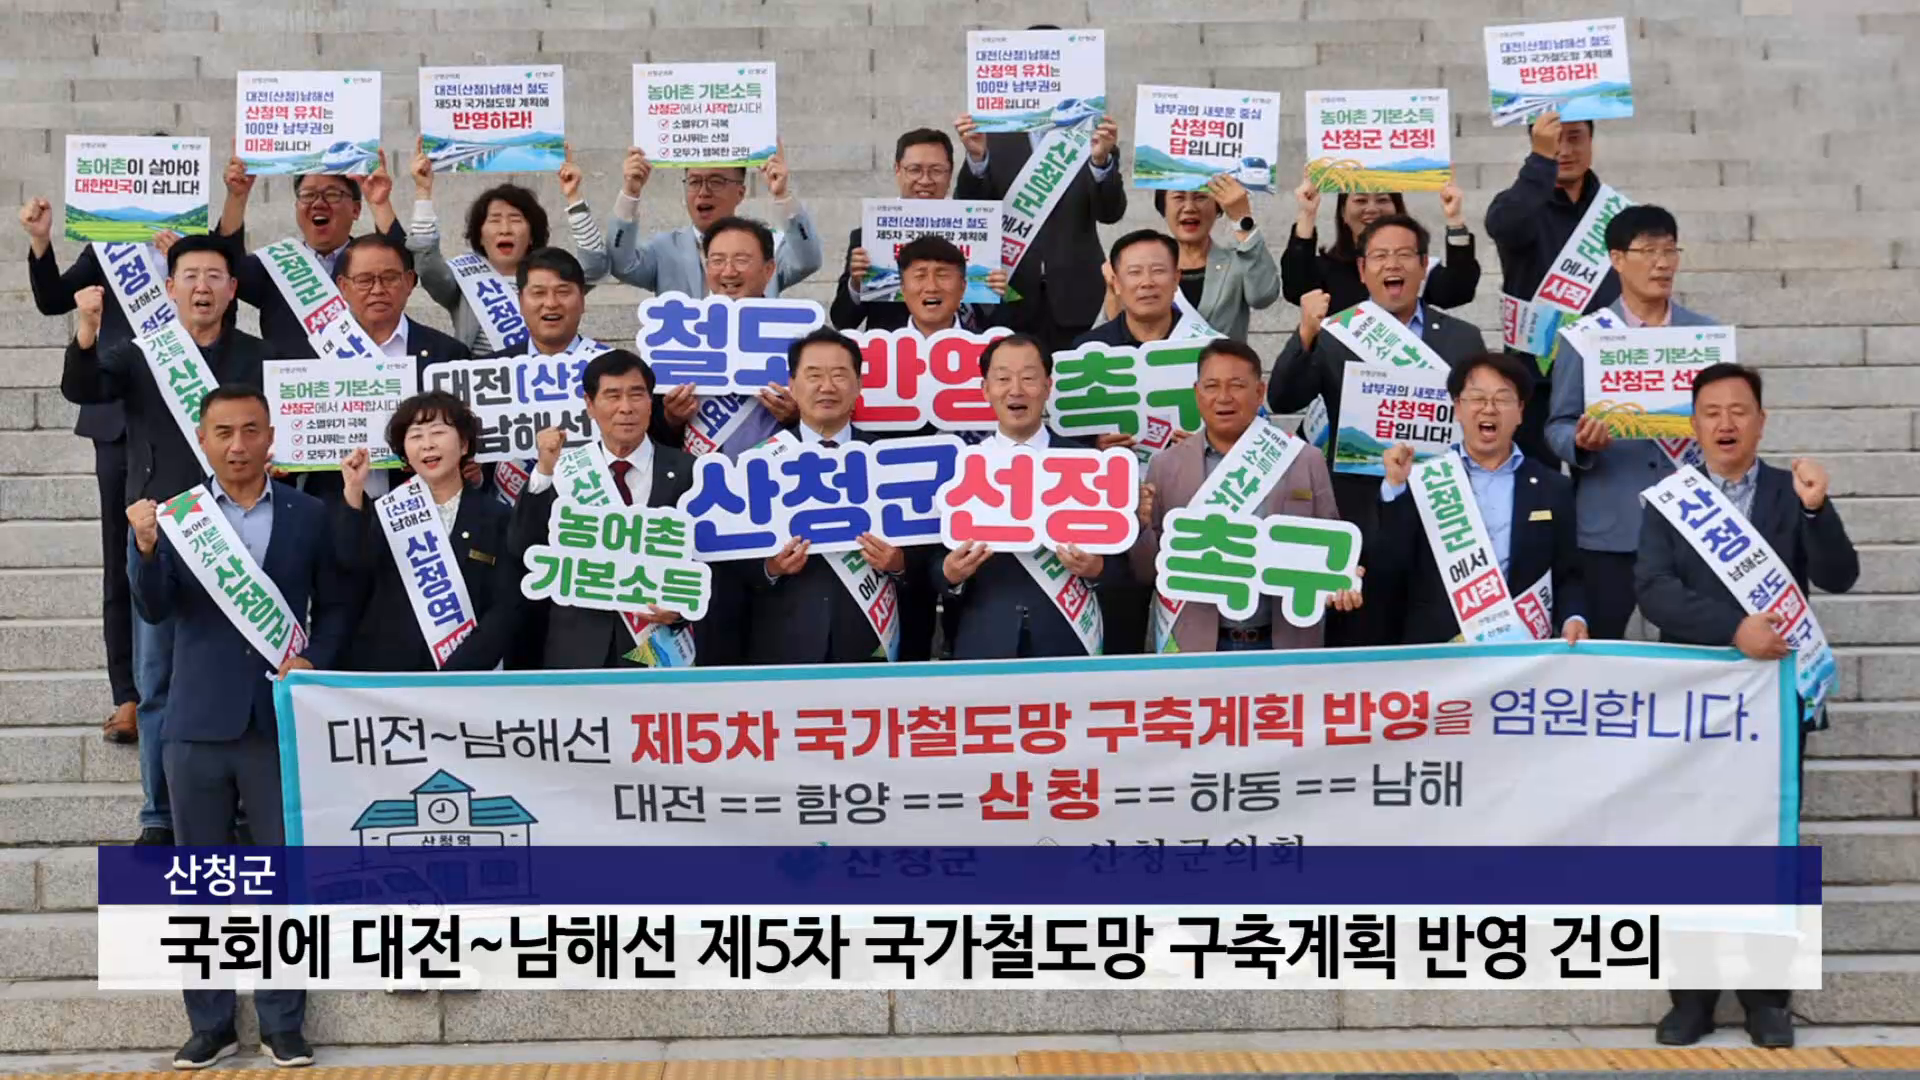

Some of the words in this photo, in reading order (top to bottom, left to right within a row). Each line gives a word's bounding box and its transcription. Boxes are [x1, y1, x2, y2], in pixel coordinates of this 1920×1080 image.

[976, 65, 1017, 79] 산청역
[1022, 64, 1060, 77] 유치는
[1520, 62, 1598, 85] 반영하라!
[527, 83, 549, 95] 철도
[647, 84, 694, 100] 농어촌
[698, 82, 762, 99] 기본소득
[976, 81, 1008, 93] 100만
[1012, 80, 1061, 93] 남부권의
[245, 105, 289, 120] 산청역
[294, 105, 333, 120] 유치는
[434, 98, 461, 109] 제5차
[465, 97, 516, 108] 국가철도망
[647, 102, 702, 115] 산청군에서
[452, 110, 533, 130] 반영하라!
[1321, 108, 1367, 125] 농어촌
[1371, 108, 1434, 124] 기본소득
[245, 122, 278, 135] 100만
[283, 122, 334, 135] 남부권의
[1170, 118, 1244, 139] 산청역이
[1321, 129, 1383, 150] 산청군
[1388, 128, 1435, 149] 선정!
[672, 148, 700, 157] 모두가
[731, 147, 750, 157] 군민
[1169, 137, 1243, 158] 답입니다!
[77, 157, 143, 176] 농어촌이
[149, 158, 200, 176] 살아야
[75, 178, 147, 194] 대한민국이
[152, 179, 200, 195] 삽니다!
[876, 229, 903, 241] 제5차
[267, 241, 328, 307] 산청군
[1560, 258, 1598, 284] 에서
[645, 299, 817, 387] 철도
[849, 335, 1001, 422] 반영
[1600, 347, 1648, 365] 농어촌
[1653, 346, 1721, 365] 기본소득
[280, 380, 329, 400] 농어촌
[334, 378, 402, 397] 기본소득
[1362, 382, 1408, 397] 남부권의
[1600, 369, 1665, 392] 산청군
[1672, 368, 1704, 391] 선
[280, 401, 338, 415] 산청군에서
[1378, 399, 1454, 424] 산청역이
[475, 408, 593, 456] 남해선
[1376, 419, 1453, 444] 답입니다!
[307, 450, 337, 460] 모두가
[371, 447, 390, 458] 군민
[572, 470, 610, 506] 산
[1420, 461, 1477, 553] 산청군
[390, 509, 433, 534] 남해선
[558, 505, 685, 559] 농어촌
[686, 444, 958, 553] 산청군
[945, 453, 1130, 544] 선정
[1166, 513, 1353, 618] 촉구
[1677, 487, 1750, 563] 산청
[188, 525, 221, 554] 기본
[1449, 547, 1489, 584] 에서
[1727, 548, 1769, 582] 남해선
[406, 530, 465, 627] 산청역
[530, 555, 703, 612] 기본소득
[1748, 568, 1787, 611] 철도
[214, 554, 291, 651] 산청군
[1459, 574, 1500, 615] 시작
[327, 715, 612, 766] 대전~남해선
[631, 710, 780, 764] 제5차
[794, 701, 1073, 761] 국가철도망
[1086, 693, 1306, 753] 구축계획
[1323, 689, 1474, 746] 반영을
[1490, 686, 1760, 743] 염원합니다.
[613, 783, 706, 825] 대전
[795, 781, 891, 826] 함양
[1189, 770, 1282, 814] 하동
[1372, 759, 1465, 809] 남해
